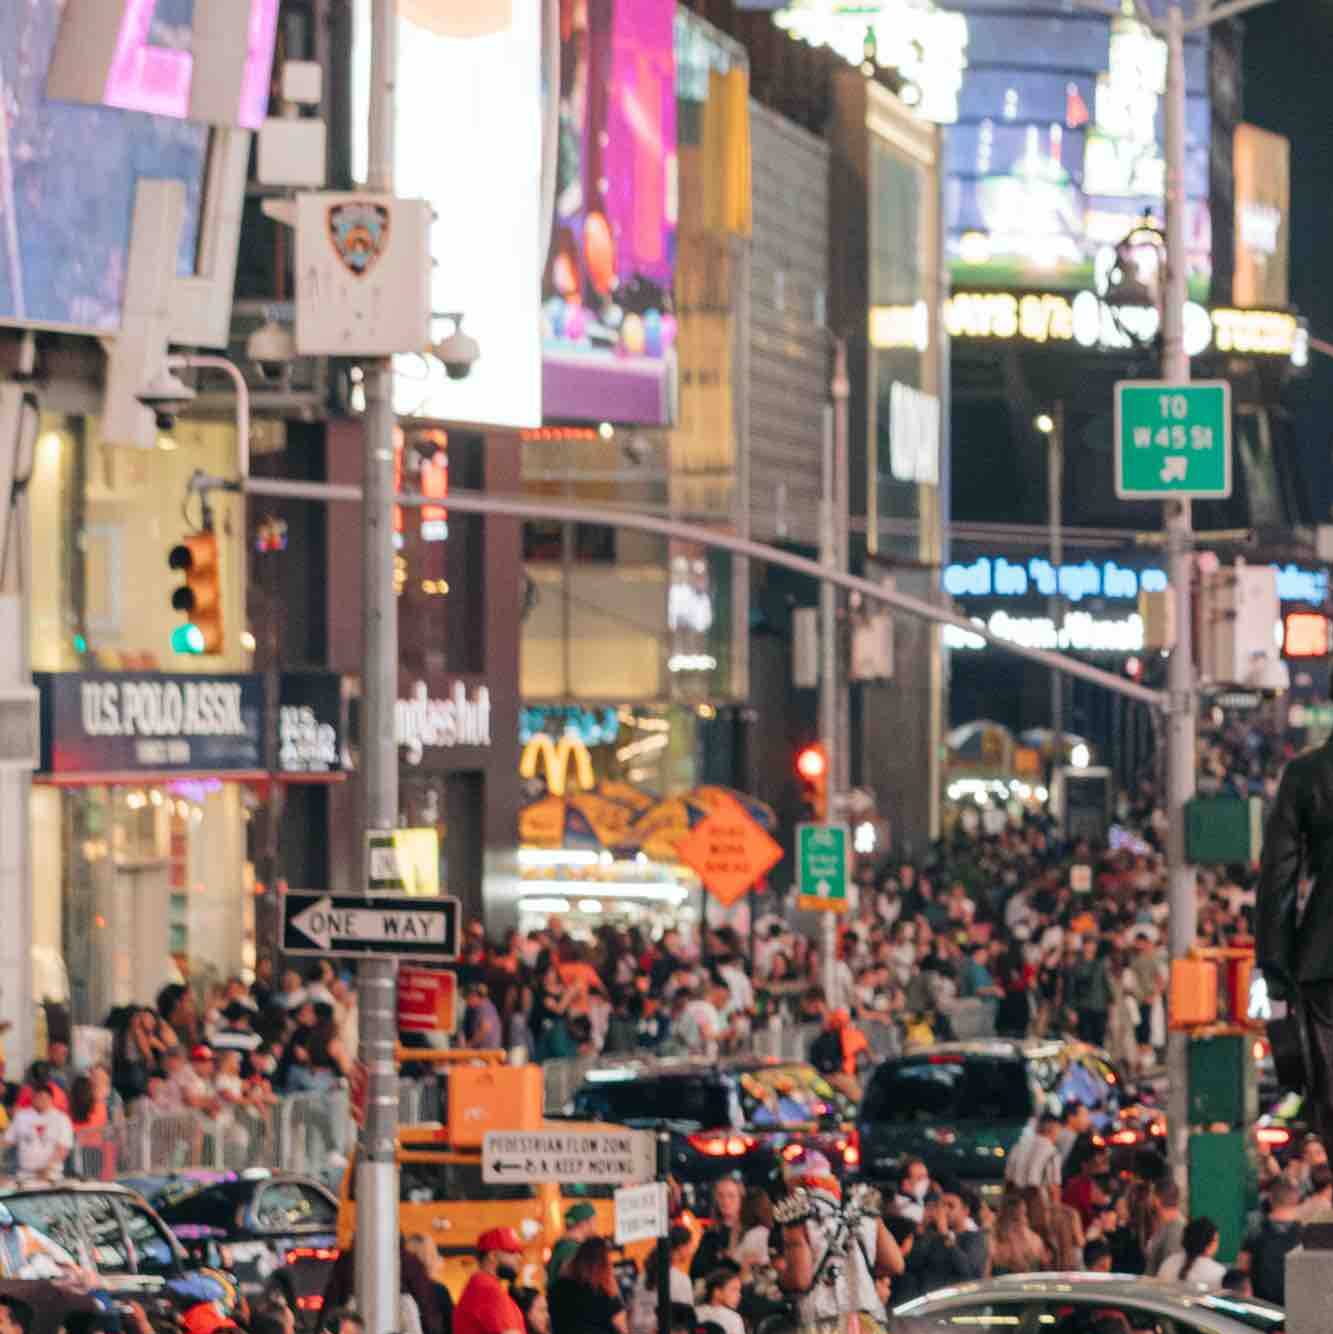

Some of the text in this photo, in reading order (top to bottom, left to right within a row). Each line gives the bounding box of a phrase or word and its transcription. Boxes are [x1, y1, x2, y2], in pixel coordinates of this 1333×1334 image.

[1158, 395, 1188, 420] TO
[1133, 427, 1151, 449] W
[1154, 426, 1187, 450] 45
[122, 682, 183, 736] POLO
[310, 912, 434, 937] ONE WAY
[489, 1137, 633, 1153] PEDESTRIAN FLOW ZONE
[554, 1160, 634, 1175] KEEP MOVING
